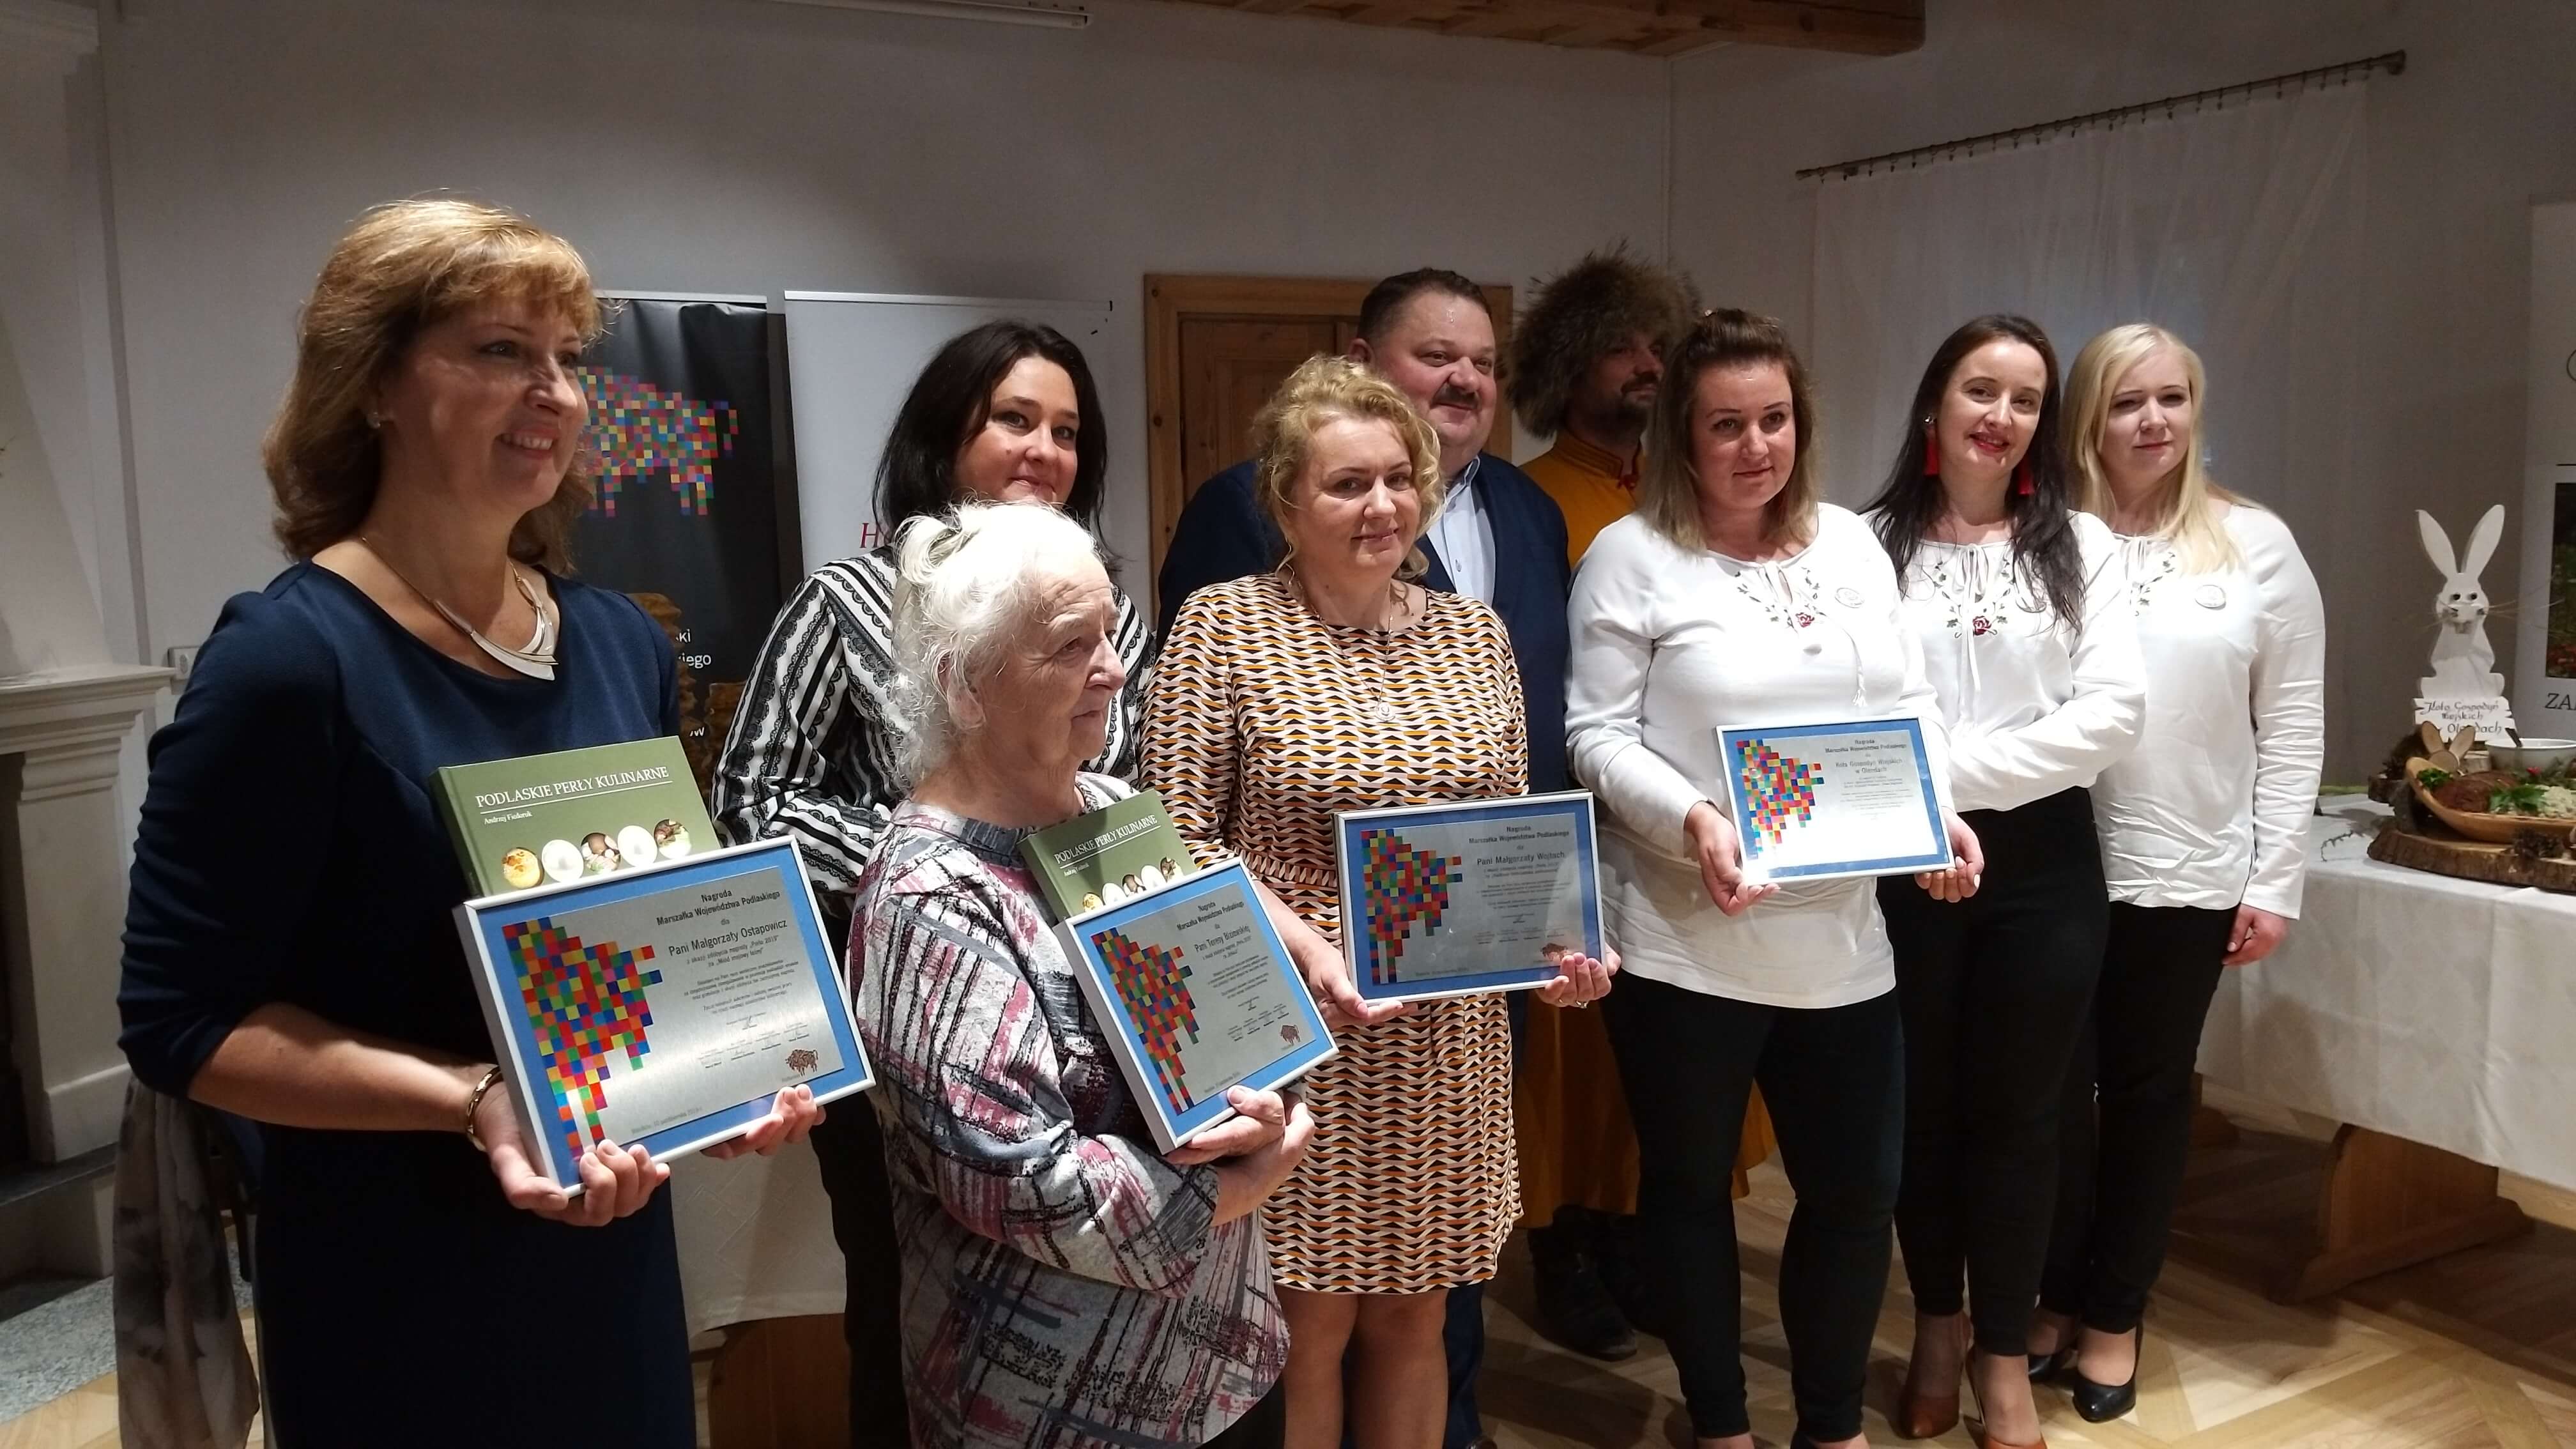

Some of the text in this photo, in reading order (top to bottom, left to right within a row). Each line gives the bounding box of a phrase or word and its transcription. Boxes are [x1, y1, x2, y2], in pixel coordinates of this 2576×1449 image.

[675, 629, 691, 643] ki
[678, 652, 712, 669] iego
[2545, 693, 2576, 710] ZA
[475, 766, 670, 808] PODLASKIE PERŁY KULINARNE
[1054, 815, 1158, 864] PODLASKIE PERŁY KULINARNE
[701, 889, 732, 903] Nagroda
[741, 891, 780, 905] Podlaskiego
[668, 946, 689, 956] Pani
[740, 920, 788, 938] Ostapowicz
